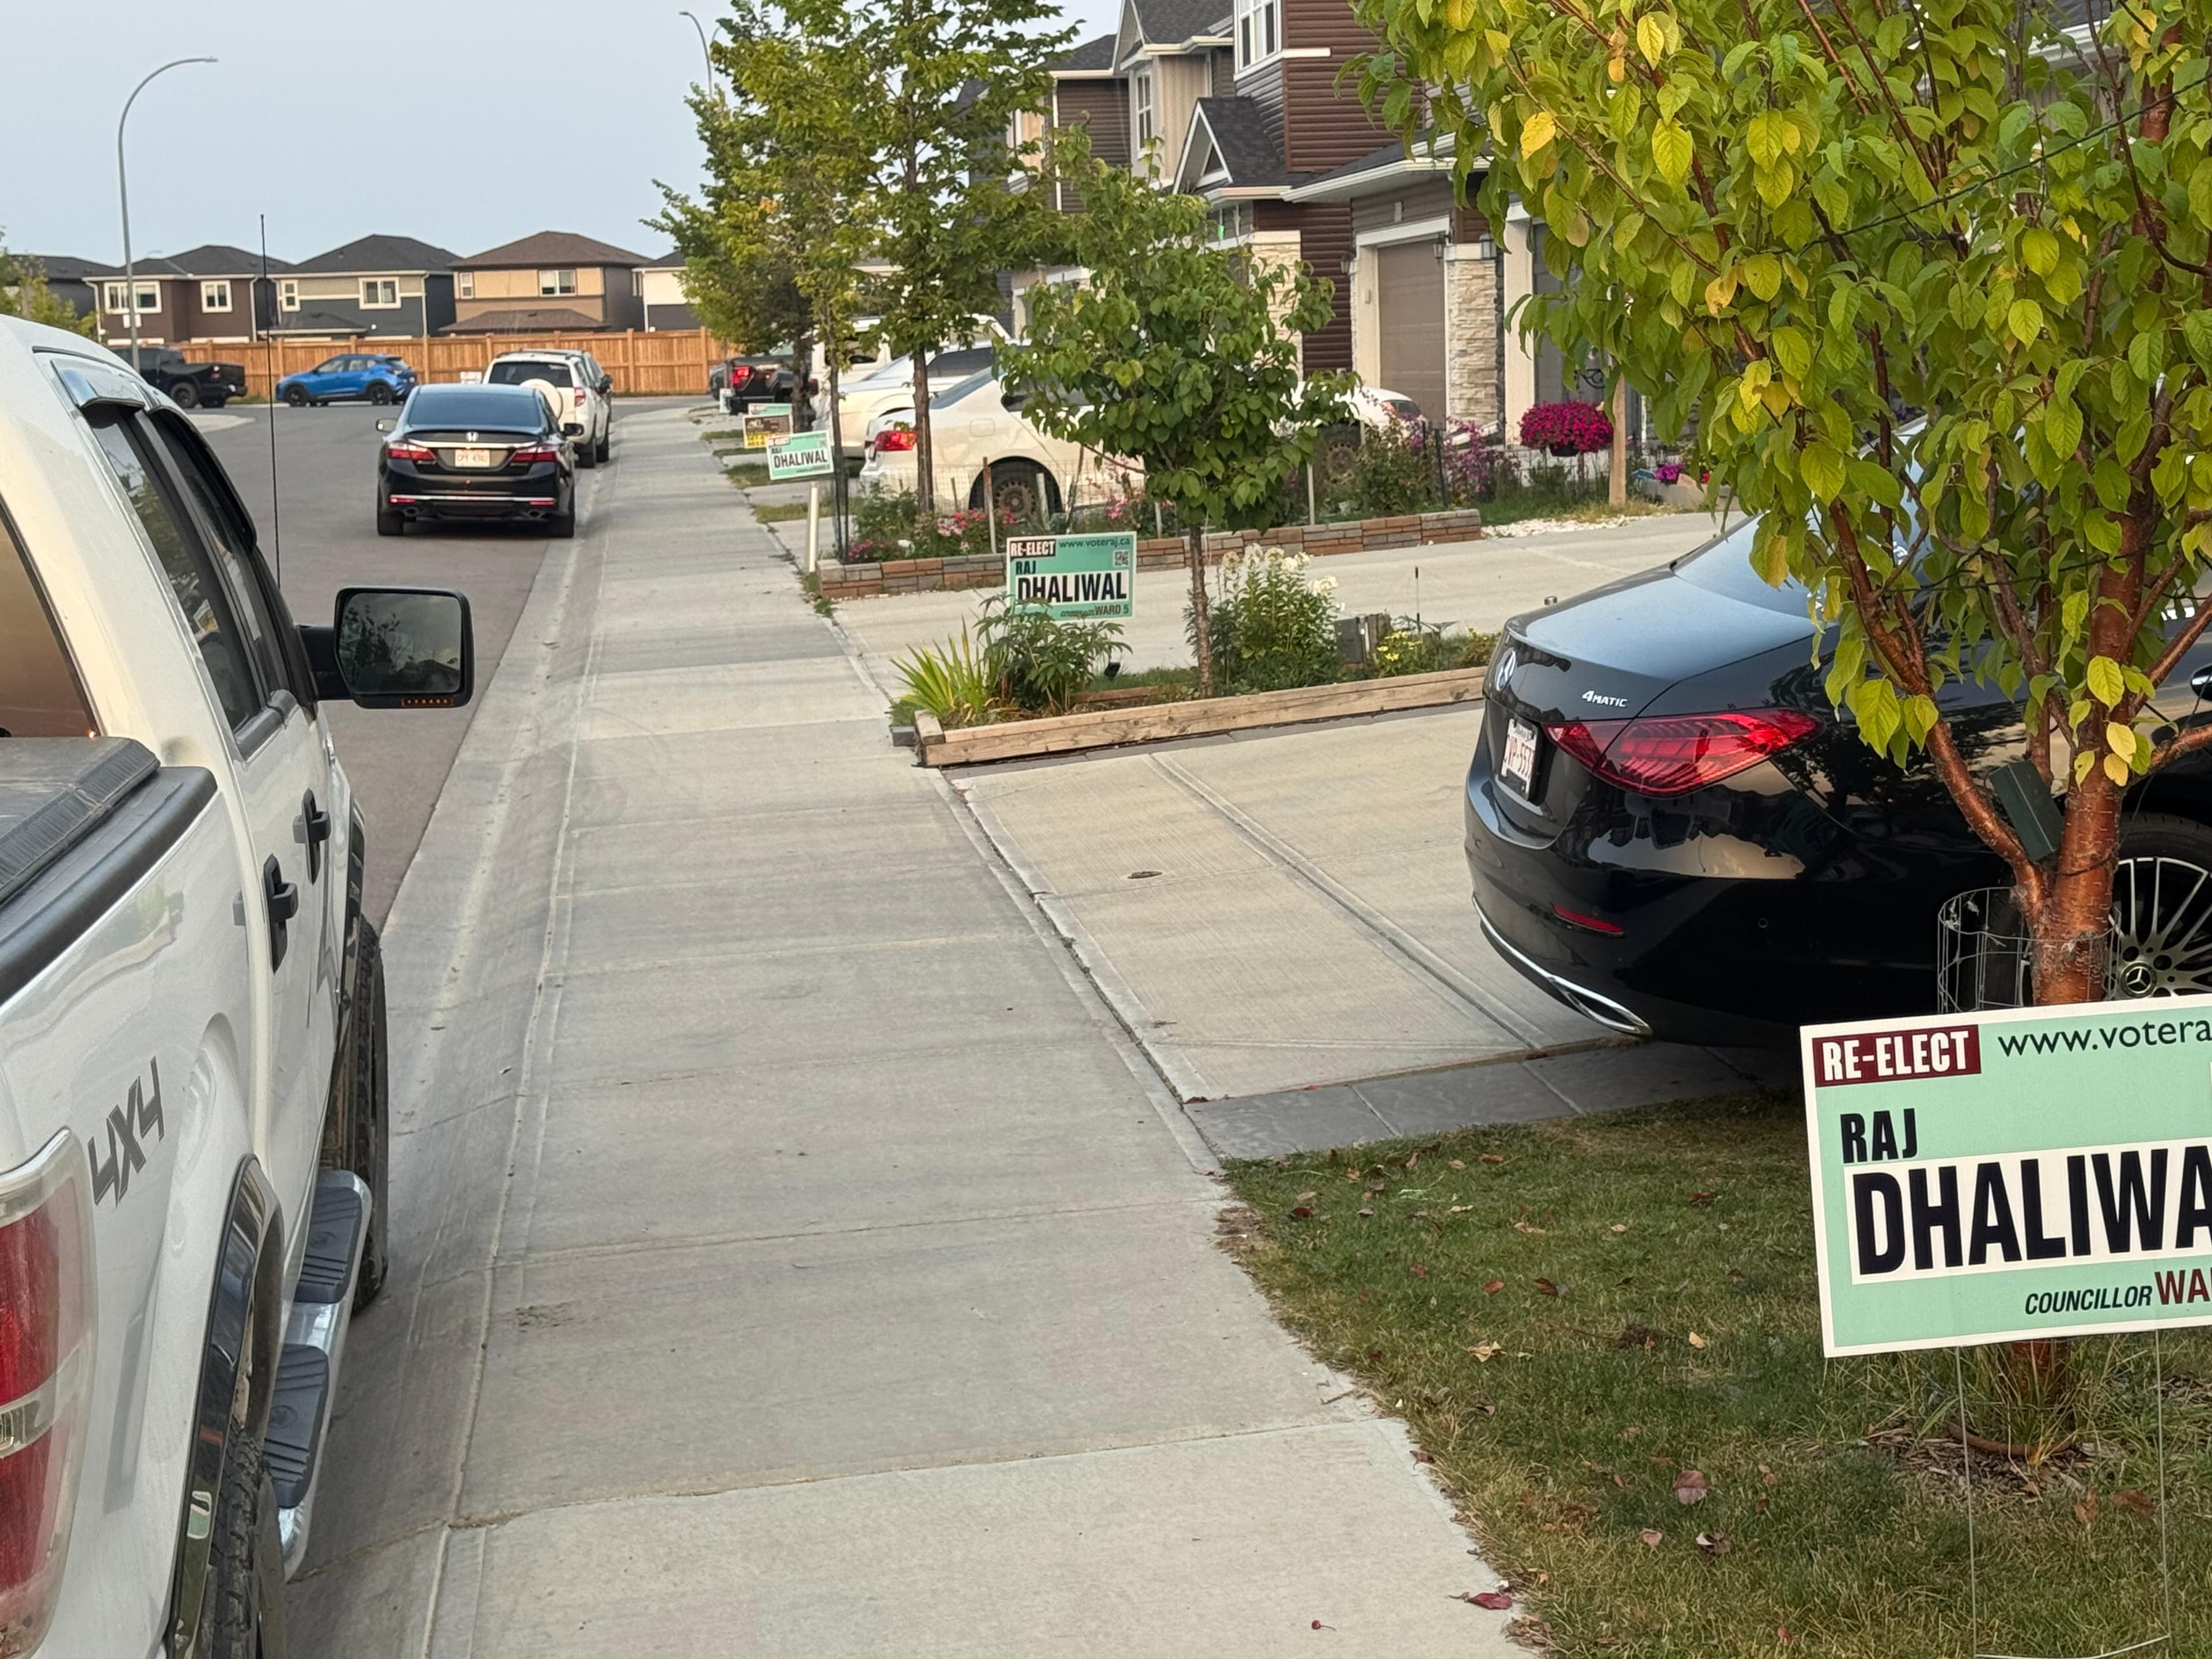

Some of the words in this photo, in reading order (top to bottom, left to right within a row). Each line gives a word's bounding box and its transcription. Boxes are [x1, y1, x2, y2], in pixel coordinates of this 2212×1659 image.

[774, 449, 828, 468] DHALIWAL
[1010, 541, 1055, 557] RE-ELECT
[1059, 537, 1130, 548] www.voteraj.ca
[1016, 560, 1036, 575] RAJ
[1018, 572, 1127, 603] DHALIWAL
[1094, 604, 1121, 616] WARD
[1123, 604, 1129, 615] 5
[1582, 691, 1628, 708] 4MATIC
[1997, 1020, 2212, 1057] www.votera
[1822, 1030, 1969, 1082] RE-ELECT
[88, 1055, 165, 1209] 4X4
[1840, 1108, 1918, 1164] RAJ
[1853, 1145, 2212, 1275] DHALIWA
[2025, 1285, 2153, 1315] COUNCILLOR
[2154, 1267, 2212, 1305] WA
